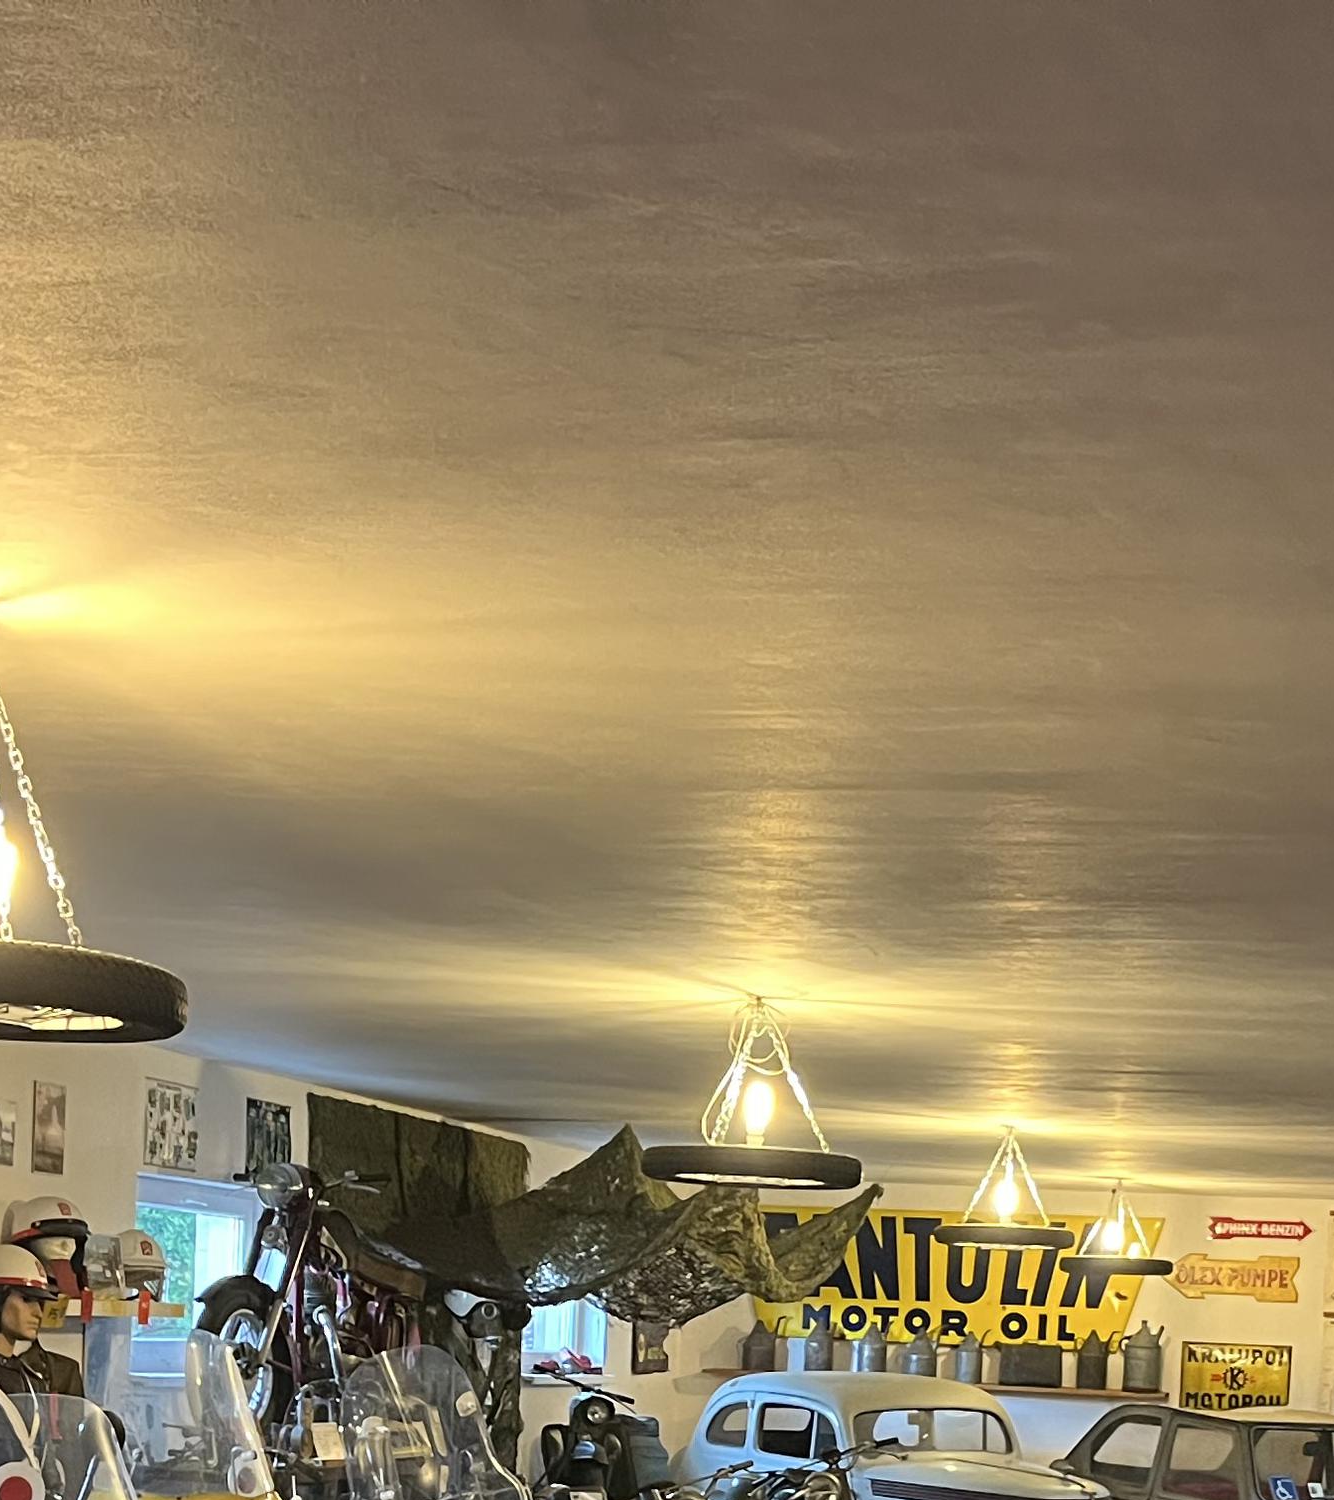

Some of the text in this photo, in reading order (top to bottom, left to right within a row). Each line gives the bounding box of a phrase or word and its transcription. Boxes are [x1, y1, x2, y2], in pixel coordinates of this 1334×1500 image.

[1227, 1267, 1290, 1289] PUMPE
[801, 1302, 1076, 1342] MOTOR OIL
